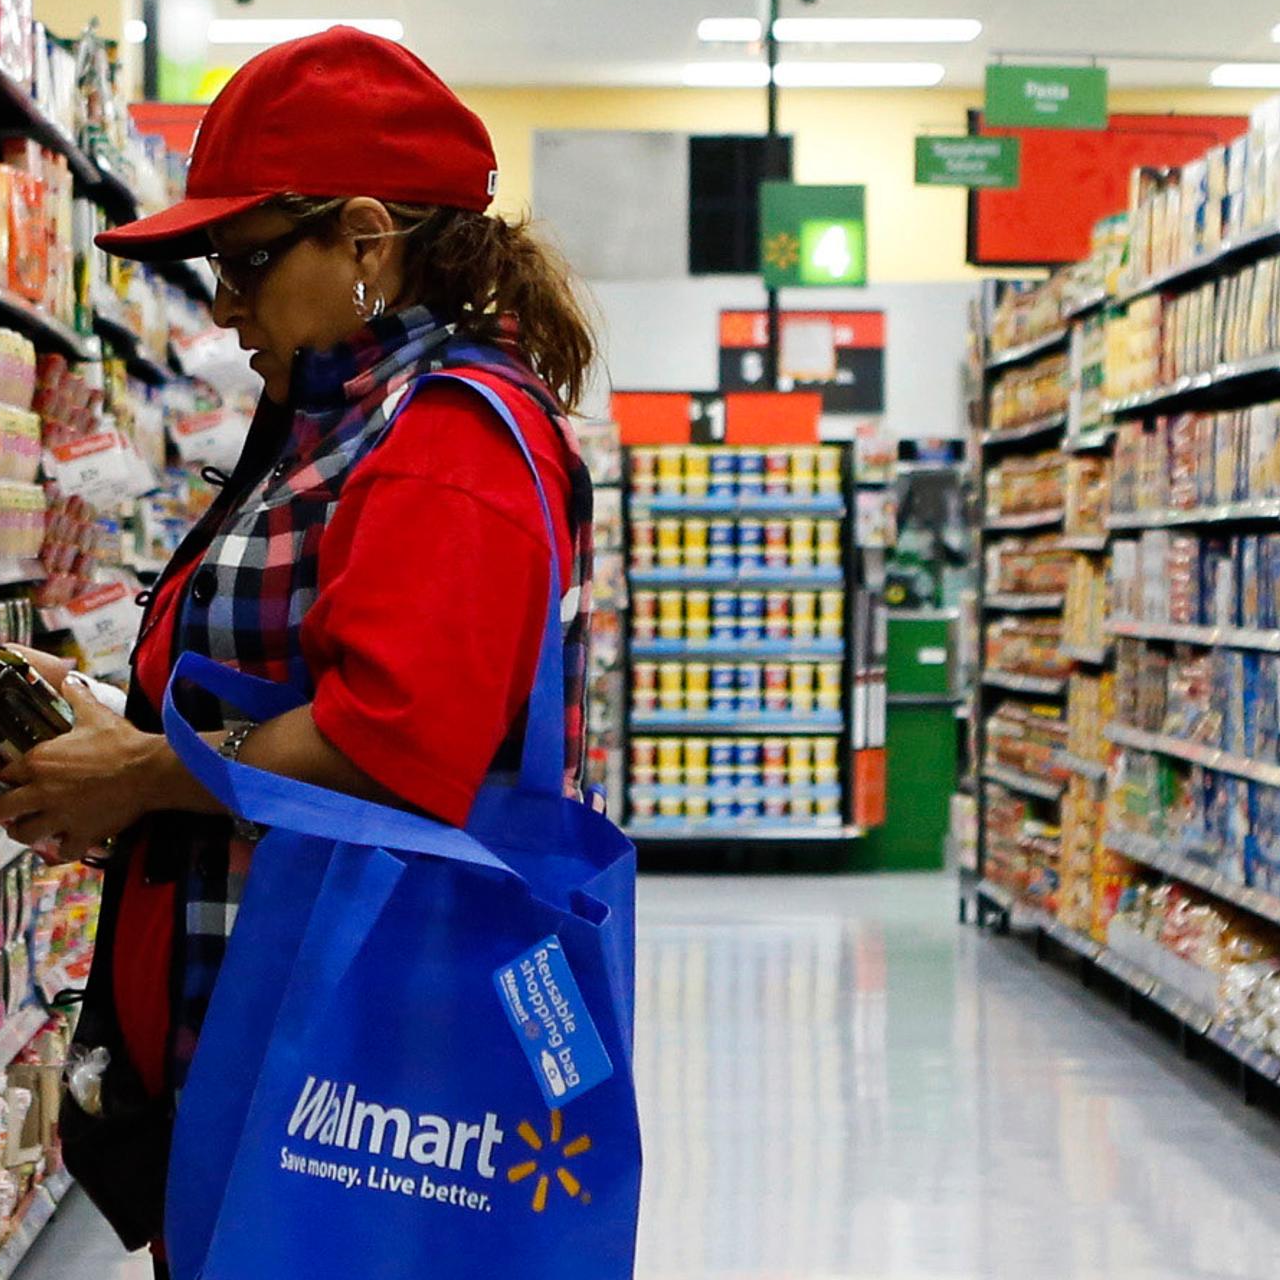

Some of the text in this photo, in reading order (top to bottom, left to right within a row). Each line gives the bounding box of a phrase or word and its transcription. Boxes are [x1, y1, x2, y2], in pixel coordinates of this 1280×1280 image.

[812, 225, 851, 278] 4
[504, 968, 530, 1023] Walmart
[520, 960, 580, 1088] shopping bag
[534, 949, 576, 1033] Reusable
[287, 1076, 504, 1179] Walmart
[281, 1146, 492, 1212] Save money. Live better.
